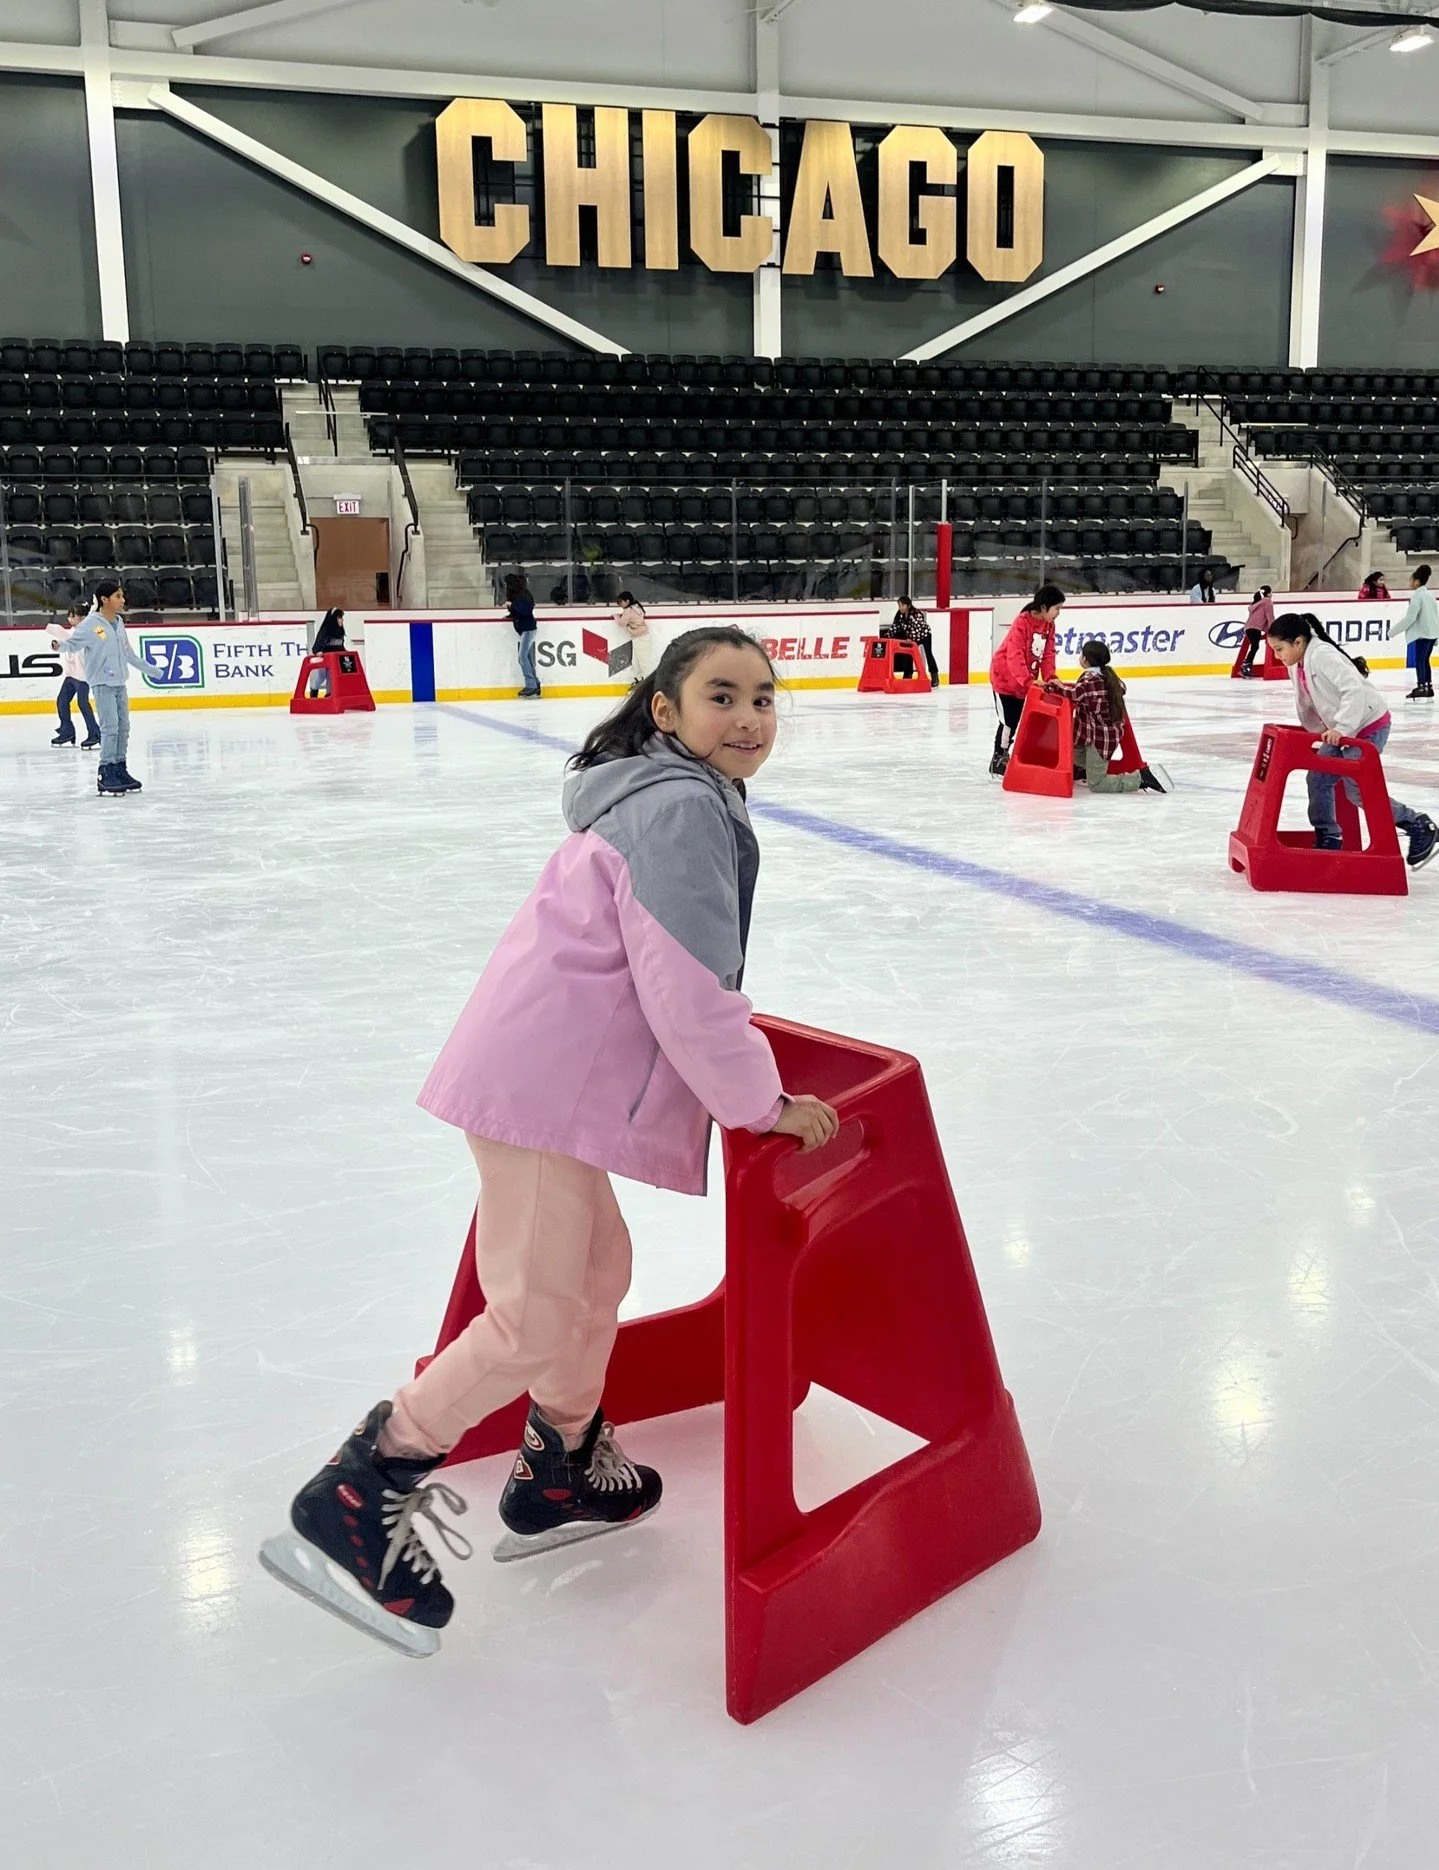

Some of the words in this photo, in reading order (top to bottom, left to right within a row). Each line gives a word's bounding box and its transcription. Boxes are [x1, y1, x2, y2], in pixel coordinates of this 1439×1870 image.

[435, 97, 1045, 282] CHICAGO
[338, 501, 356, 513] EXIT
[1322, 619, 1391, 642] NDAI
[213, 643, 272, 658] FIFTH
[760, 636, 850, 661] BELLE
[214, 663, 274, 678] BANK
